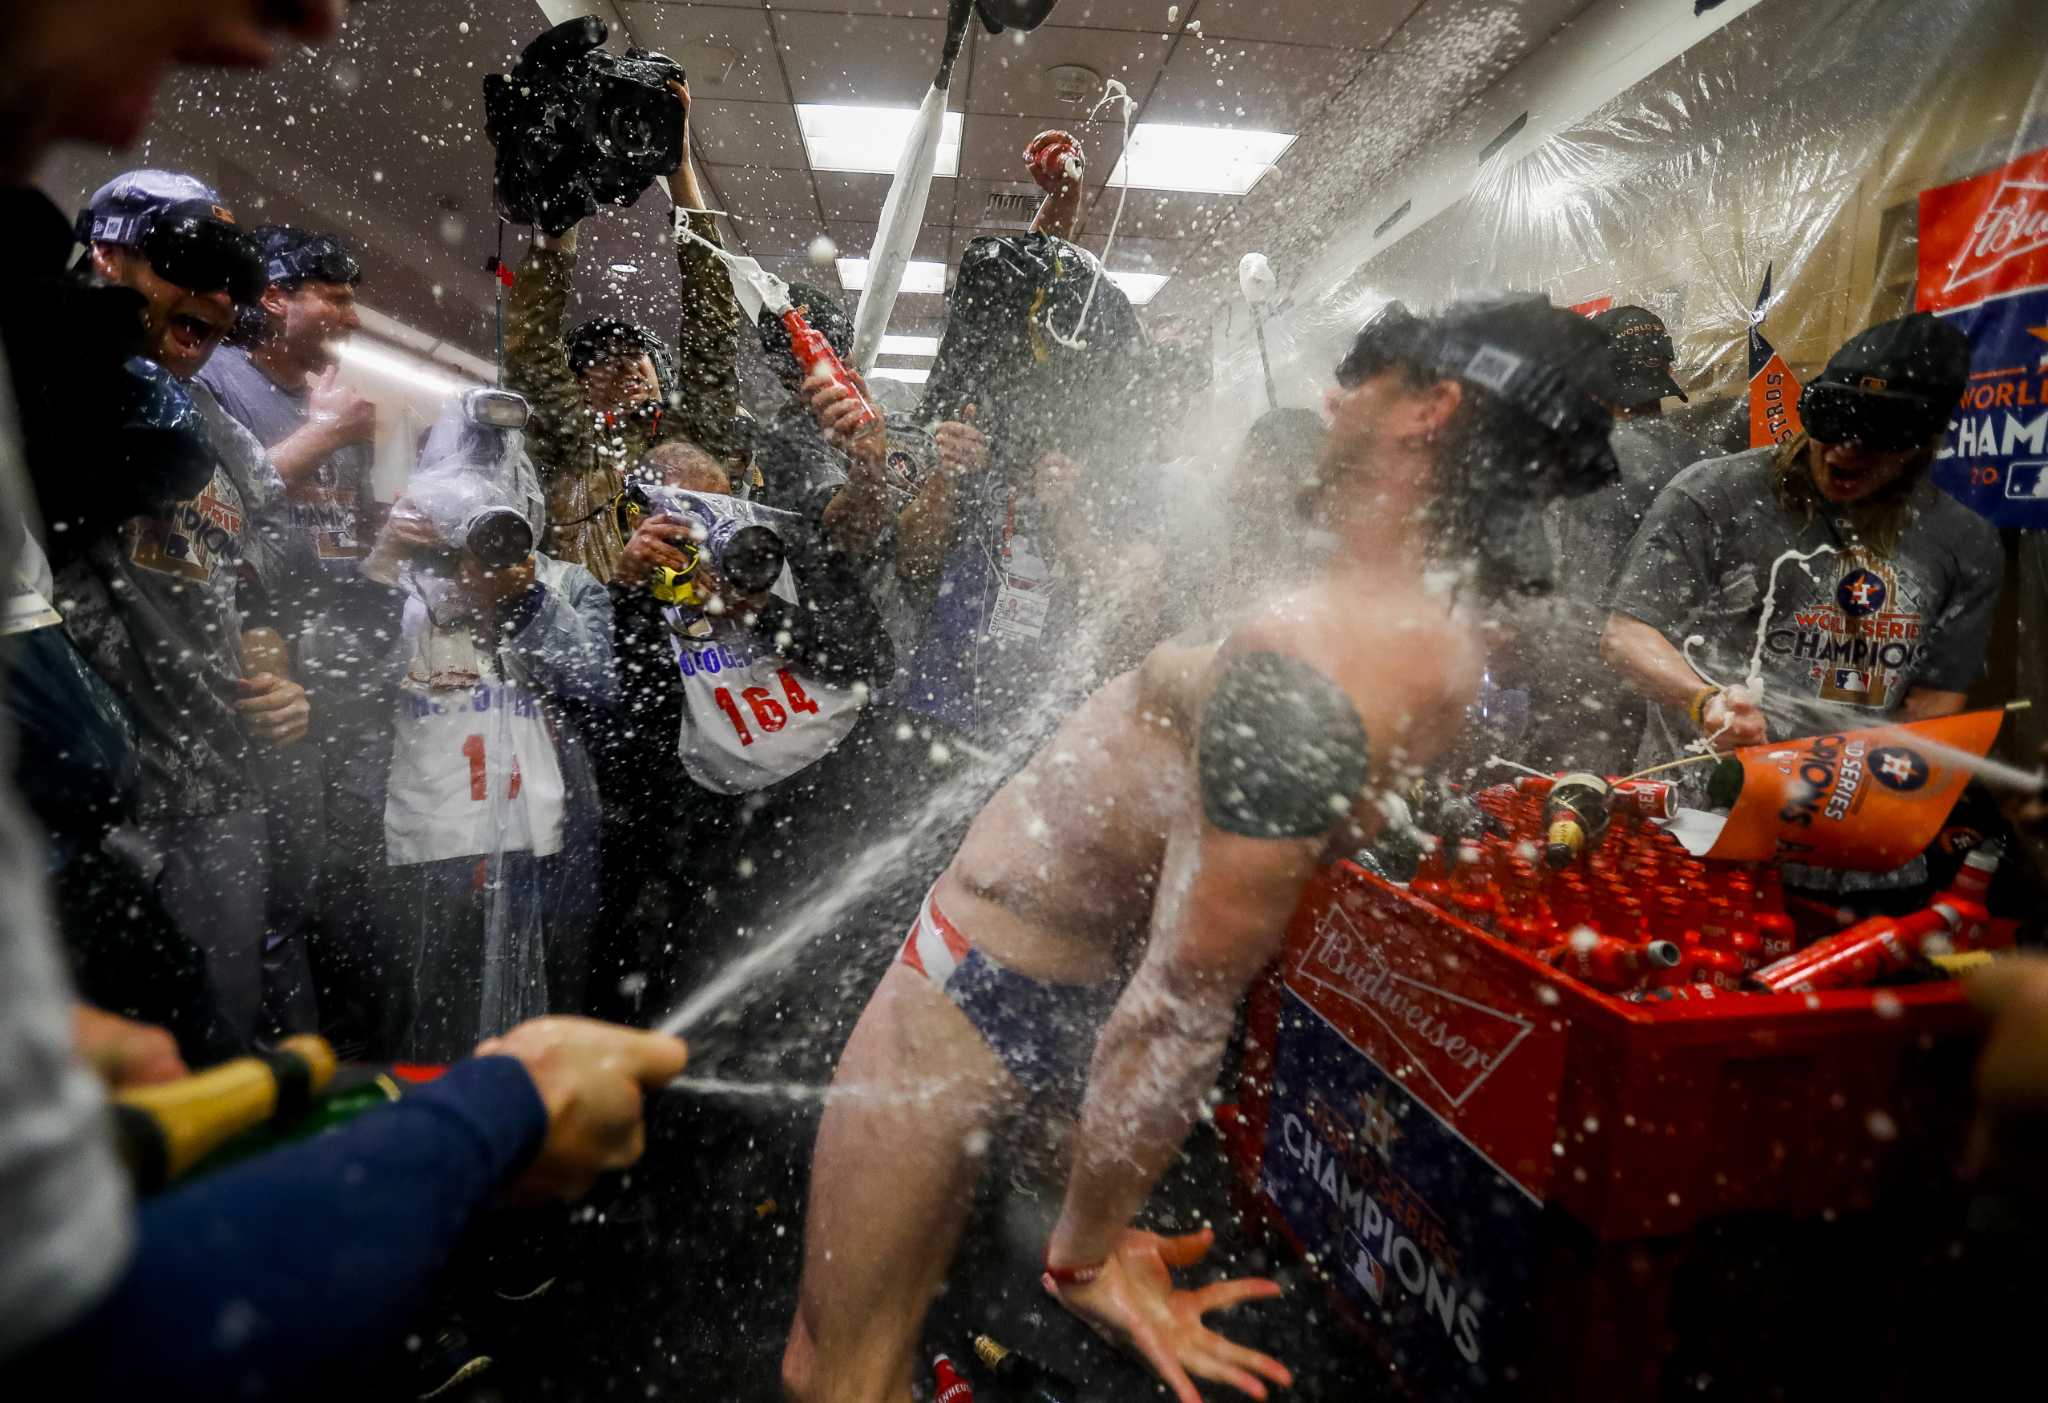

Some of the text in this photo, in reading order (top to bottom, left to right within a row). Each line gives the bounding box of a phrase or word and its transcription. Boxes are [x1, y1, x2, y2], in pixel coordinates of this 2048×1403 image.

[714, 668, 820, 747] 164
[1823, 757, 1862, 820] SERIES
[1314, 917, 1493, 1070] Budweiser
[1283, 1112, 1481, 1364] CHAMPIONS
